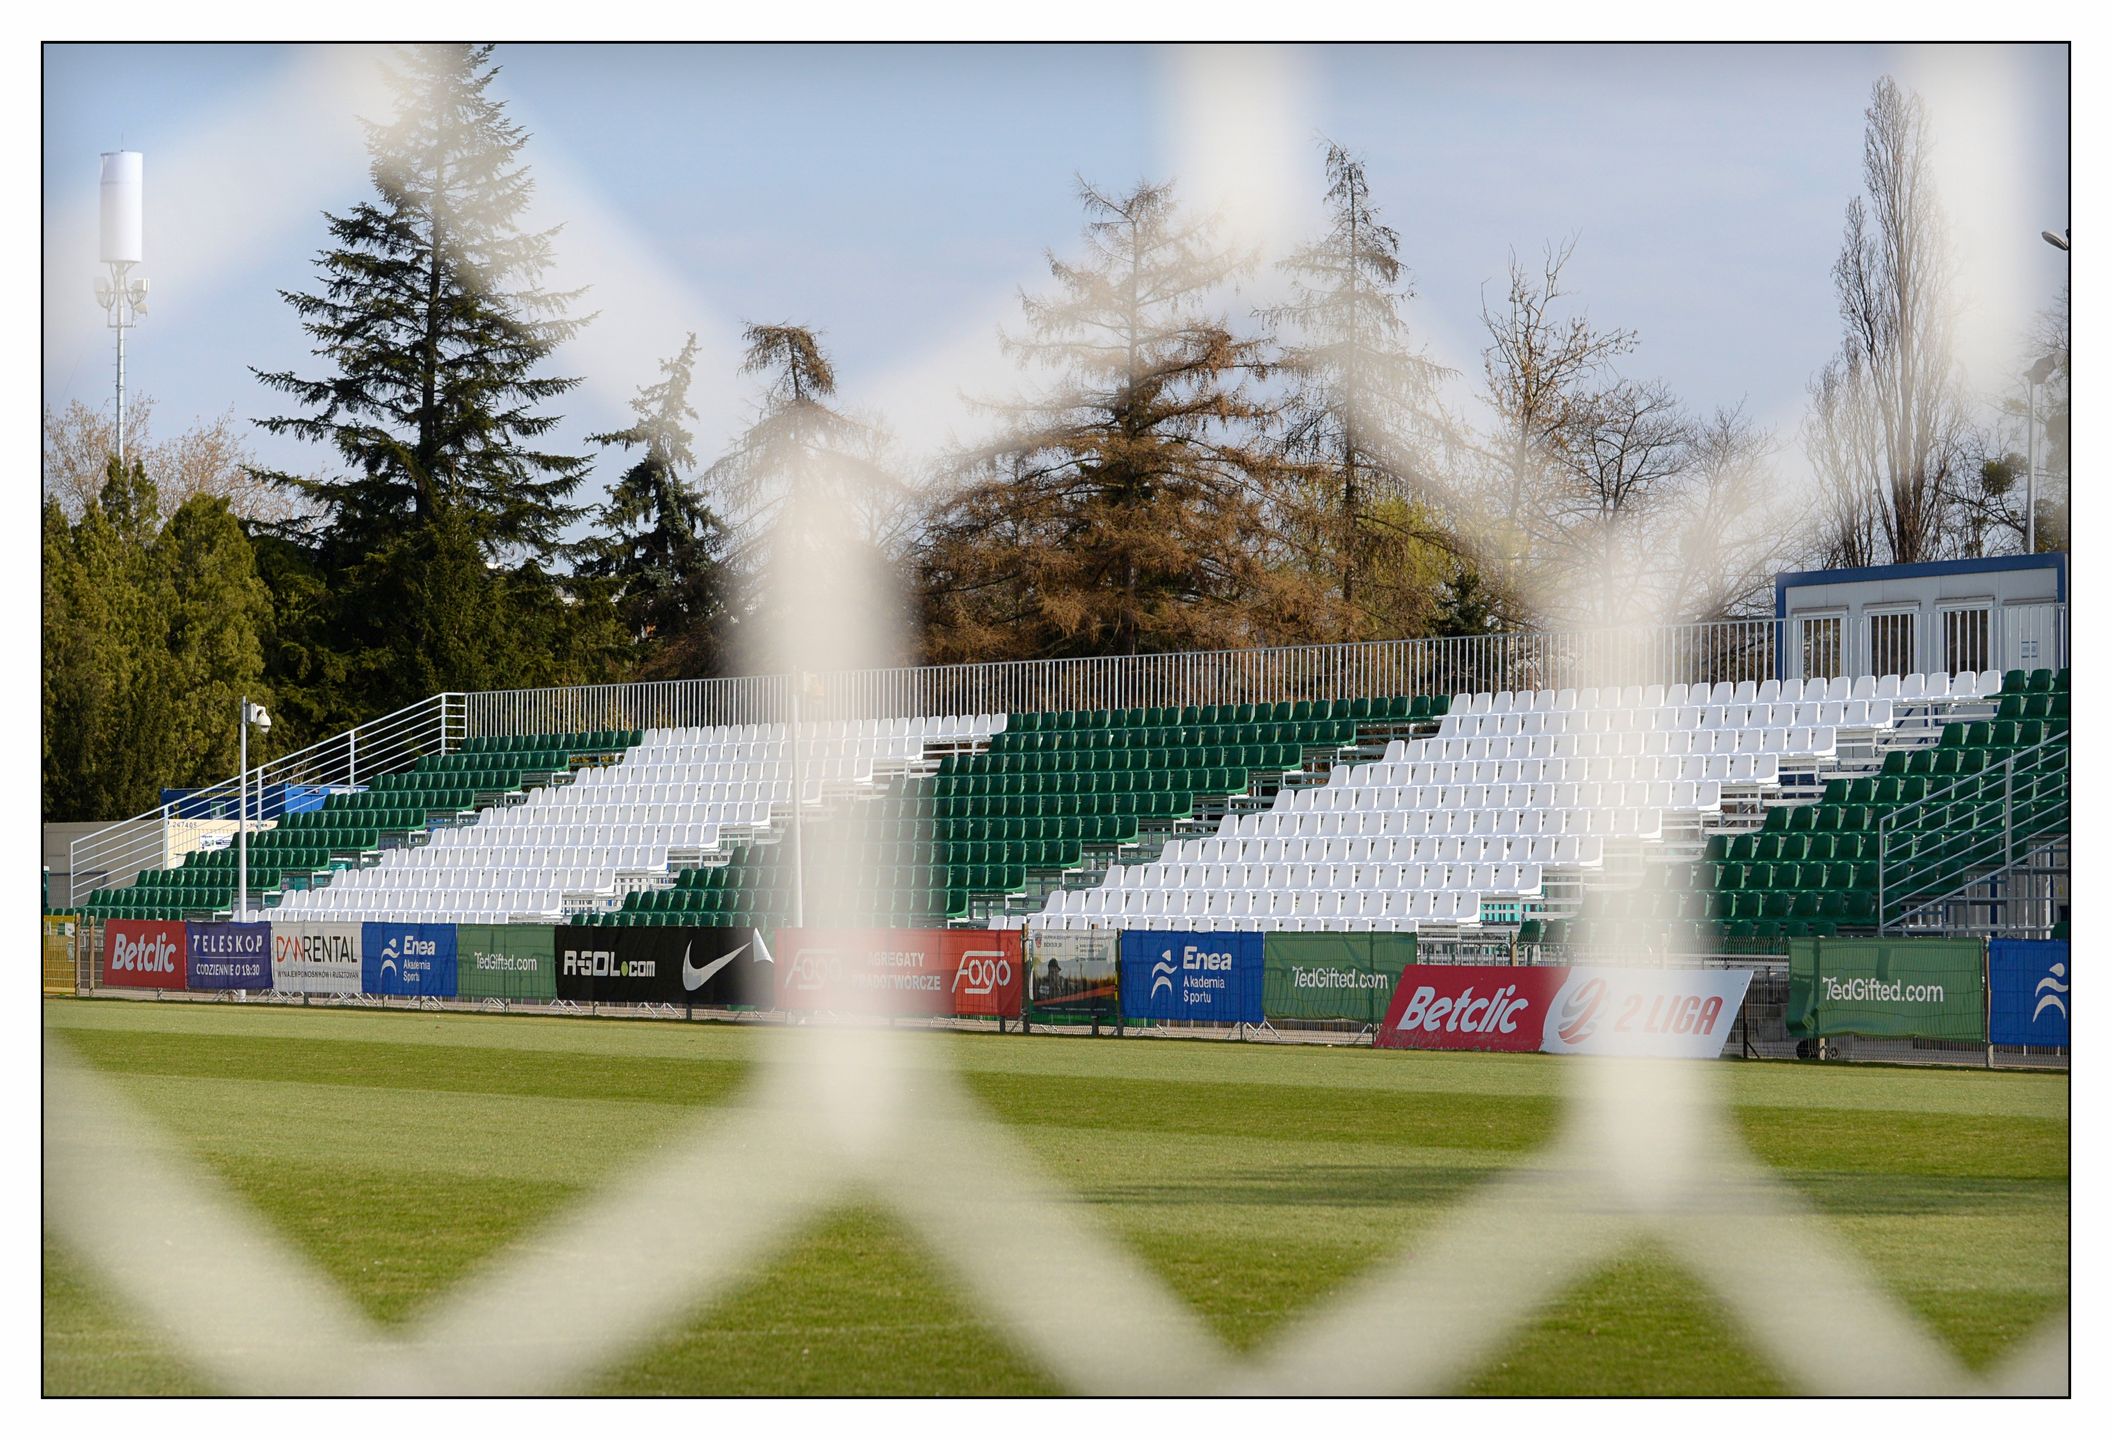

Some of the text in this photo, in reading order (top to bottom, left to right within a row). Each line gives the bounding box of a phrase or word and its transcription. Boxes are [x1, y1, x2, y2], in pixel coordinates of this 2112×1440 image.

[112, 932, 176, 973] Betclic
[193, 935, 263, 953] TELESKOP
[403, 935, 436, 956] Enea
[403, 959, 431, 970] Akademia
[474, 951, 538, 971] TedGifted.com
[563, 950, 656, 977] R-GOL.com
[868, 951, 925, 968] AGREGATY
[1183, 946, 1232, 971] Enea
[196, 963, 260, 976] CODZIENNIE O 18:30
[403, 971, 420, 983] Sportu
[952, 950, 1012, 994] Fogo
[1292, 966, 1389, 990] TedGifted.com
[1183, 975, 1225, 989] Akademia
[1822, 976, 1944, 1002] TedGifted.com
[1183, 990, 1212, 1004] Sportu
[1396, 984, 1529, 1034] Betclic
[1614, 994, 1724, 1036] 2 LIGA
